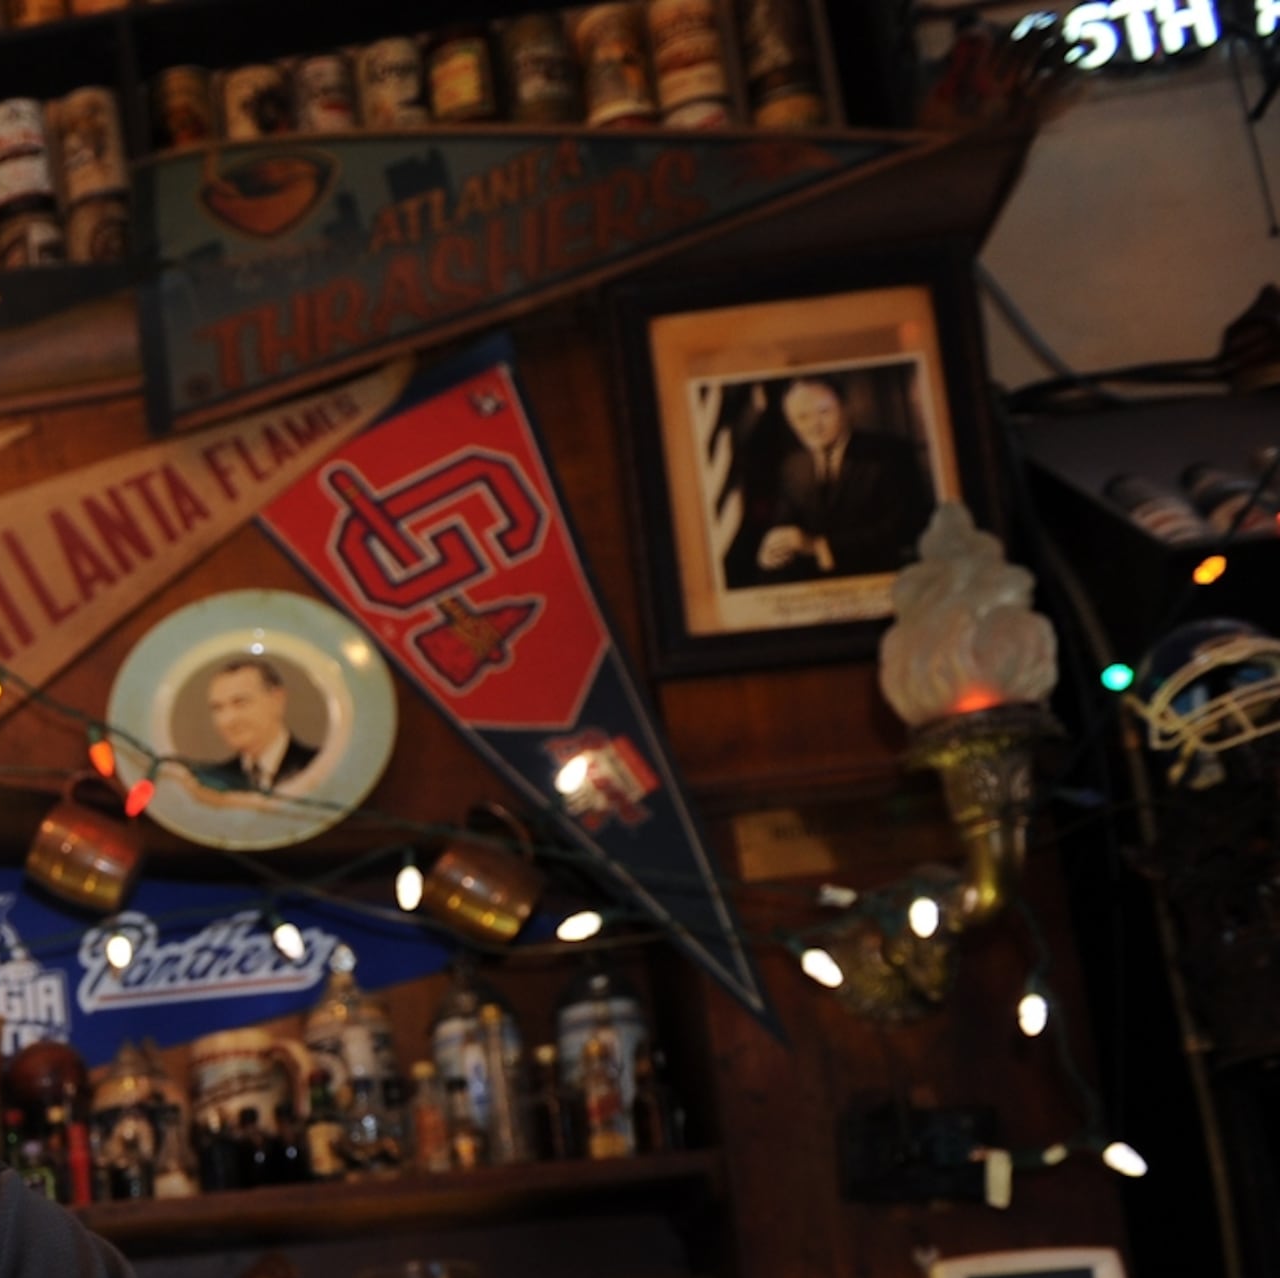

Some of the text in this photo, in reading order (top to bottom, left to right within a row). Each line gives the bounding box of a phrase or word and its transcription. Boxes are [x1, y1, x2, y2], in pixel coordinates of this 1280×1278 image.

[369, 139, 585, 253] ATLANTA
[194, 148, 710, 390] THRASHERS
[205, 395, 362, 502] FLAMES
